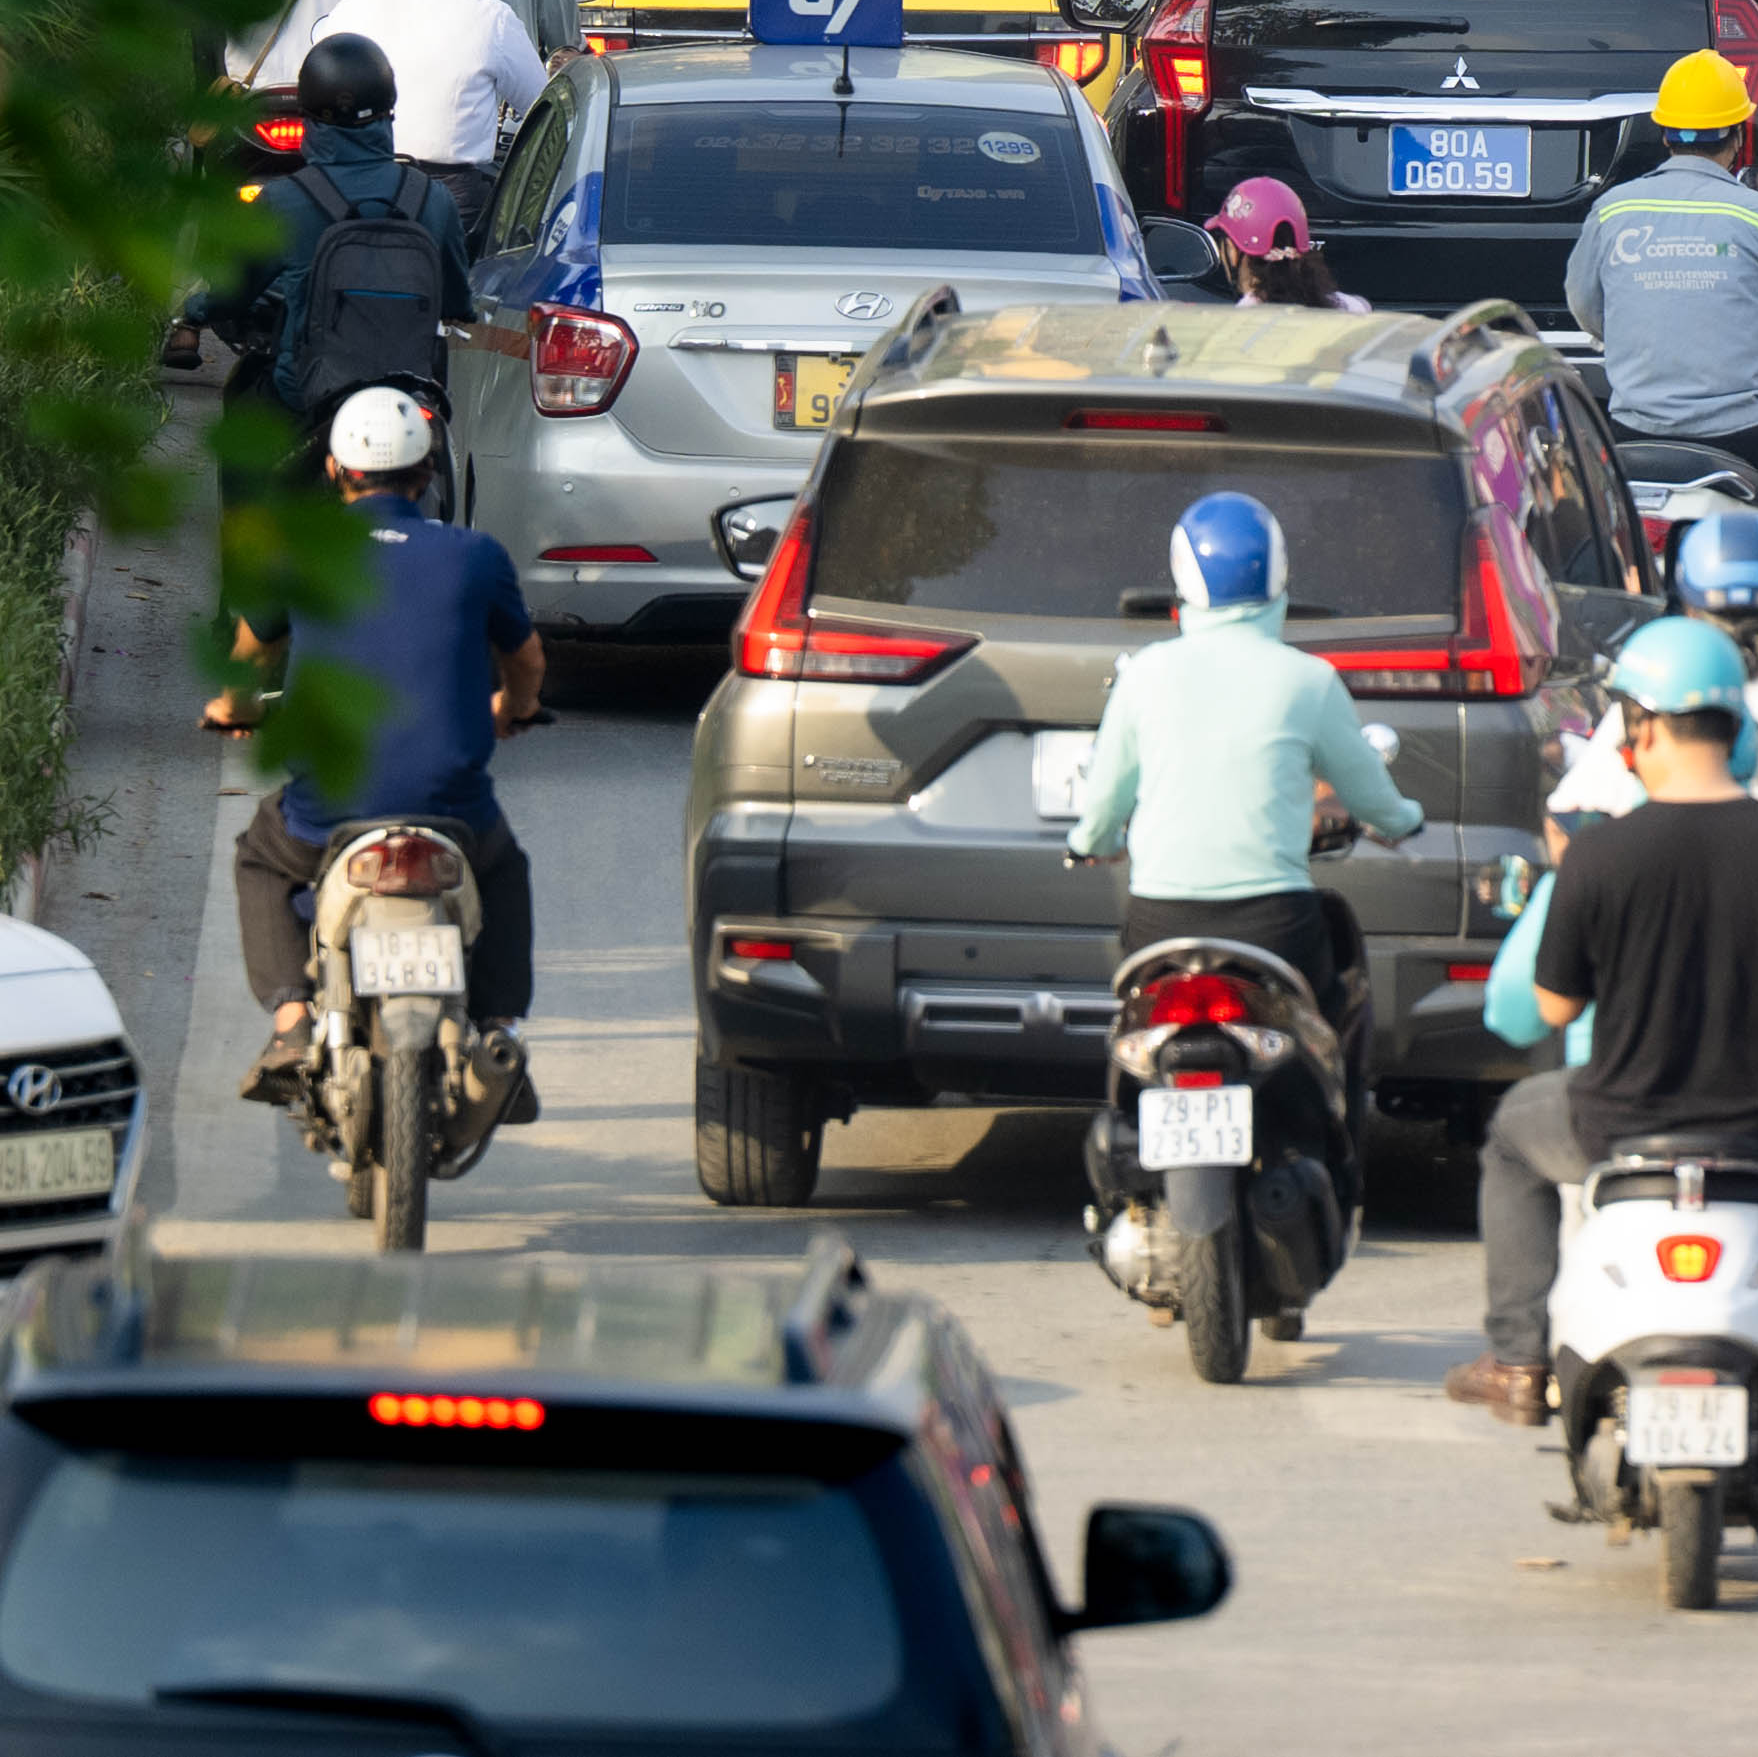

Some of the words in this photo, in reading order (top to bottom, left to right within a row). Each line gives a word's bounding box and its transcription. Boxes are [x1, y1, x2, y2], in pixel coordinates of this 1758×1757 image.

[983, 139, 1035, 156] 1299
[1430, 129, 1489, 159] 80A
[1406, 160, 1513, 190] 060.59
[1161, 1092, 1233, 1125] 29-P1
